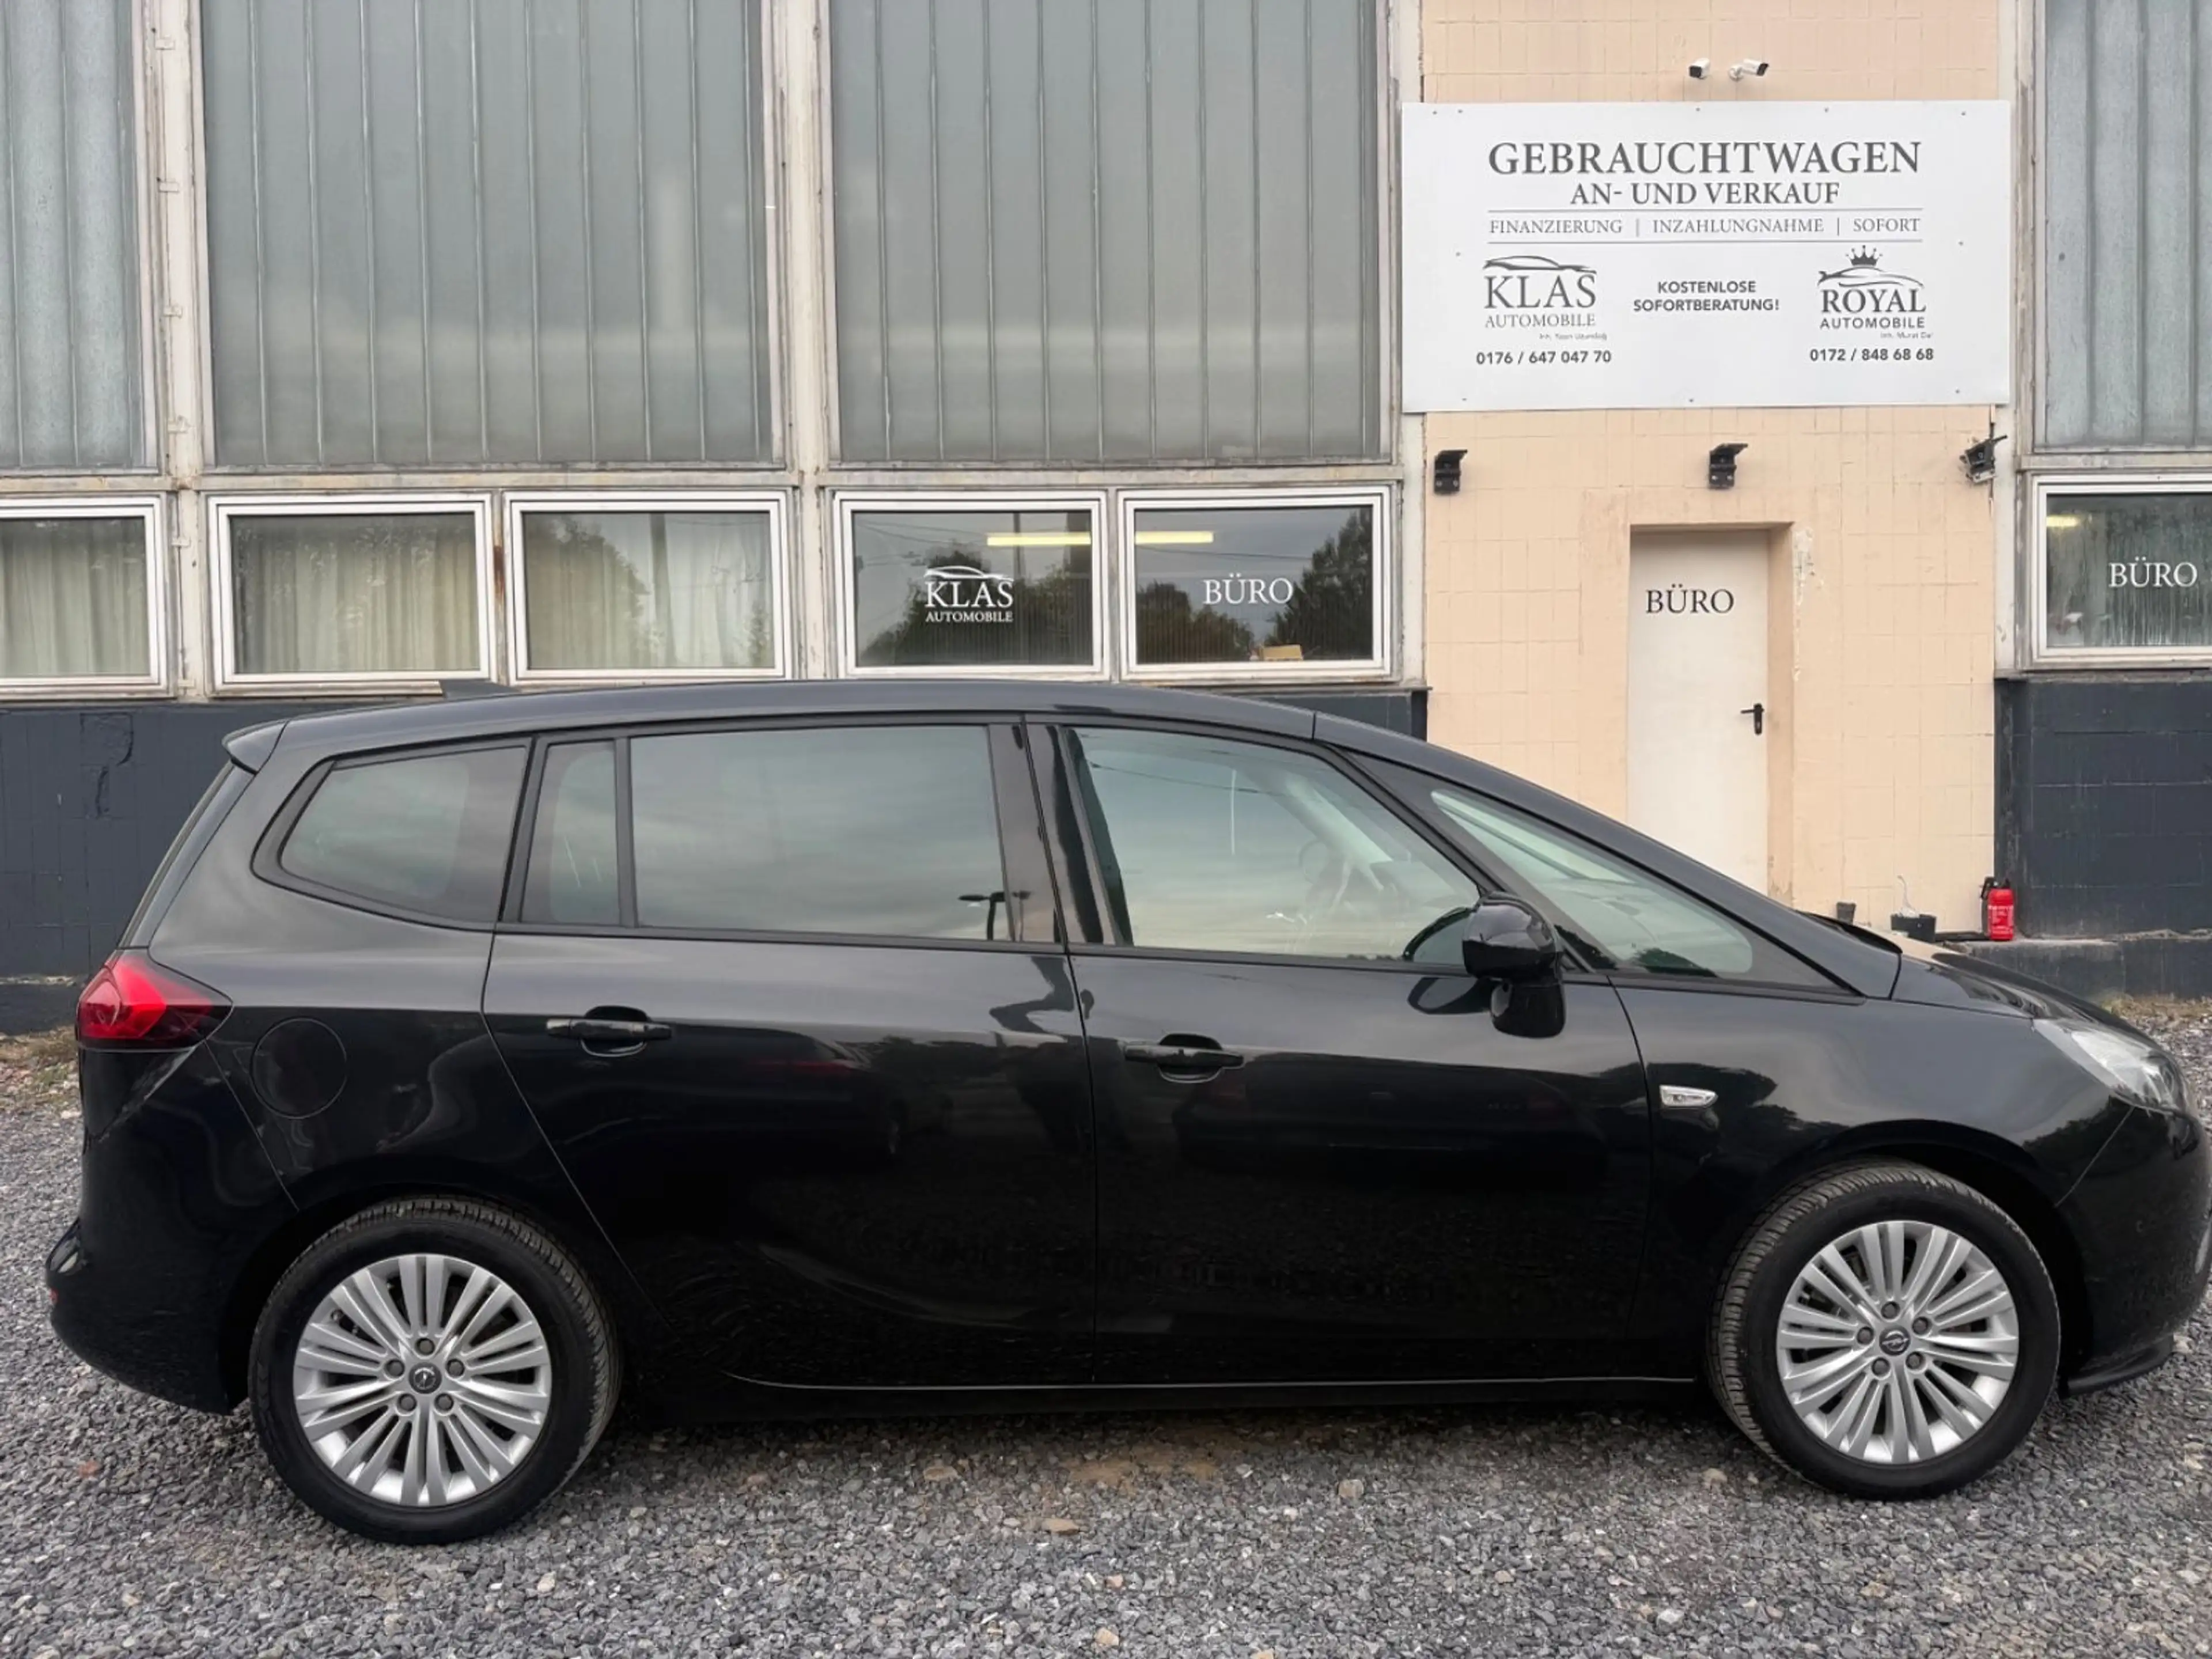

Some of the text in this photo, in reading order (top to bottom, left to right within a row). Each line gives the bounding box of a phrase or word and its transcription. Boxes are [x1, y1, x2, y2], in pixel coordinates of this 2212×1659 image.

[1488, 141, 1921, 175] GEBRAUCHTWAGEN
[1570, 181, 1840, 205] AN- UND VERKAUF
[1490, 218, 1921, 234] FINANZIERUNG INZAHLUNGNAHME SOFORT
[1484, 274, 1596, 309] KLAS
[1657, 280, 1756, 294] KOSTENLOSE
[1633, 298, 1779, 312] SOFORTBERATUNG!
[1821, 289, 1927, 313] ROYAL
[1485, 313, 1595, 328] AUTOMOBILE
[1820, 316, 1925, 329] AUTOMOBILE
[1475, 350, 1612, 365] 0176 / 647 047 70
[1809, 347, 1934, 362] 0172 / 848 68 68
[2109, 556, 2198, 588] BÜRO
[923, 581, 1014, 608] KLAS
[1204, 573, 1293, 604] BÜRO
[1646, 583, 1735, 614] BÜRO
[925, 611, 1013, 623] AUTOMOBILE
